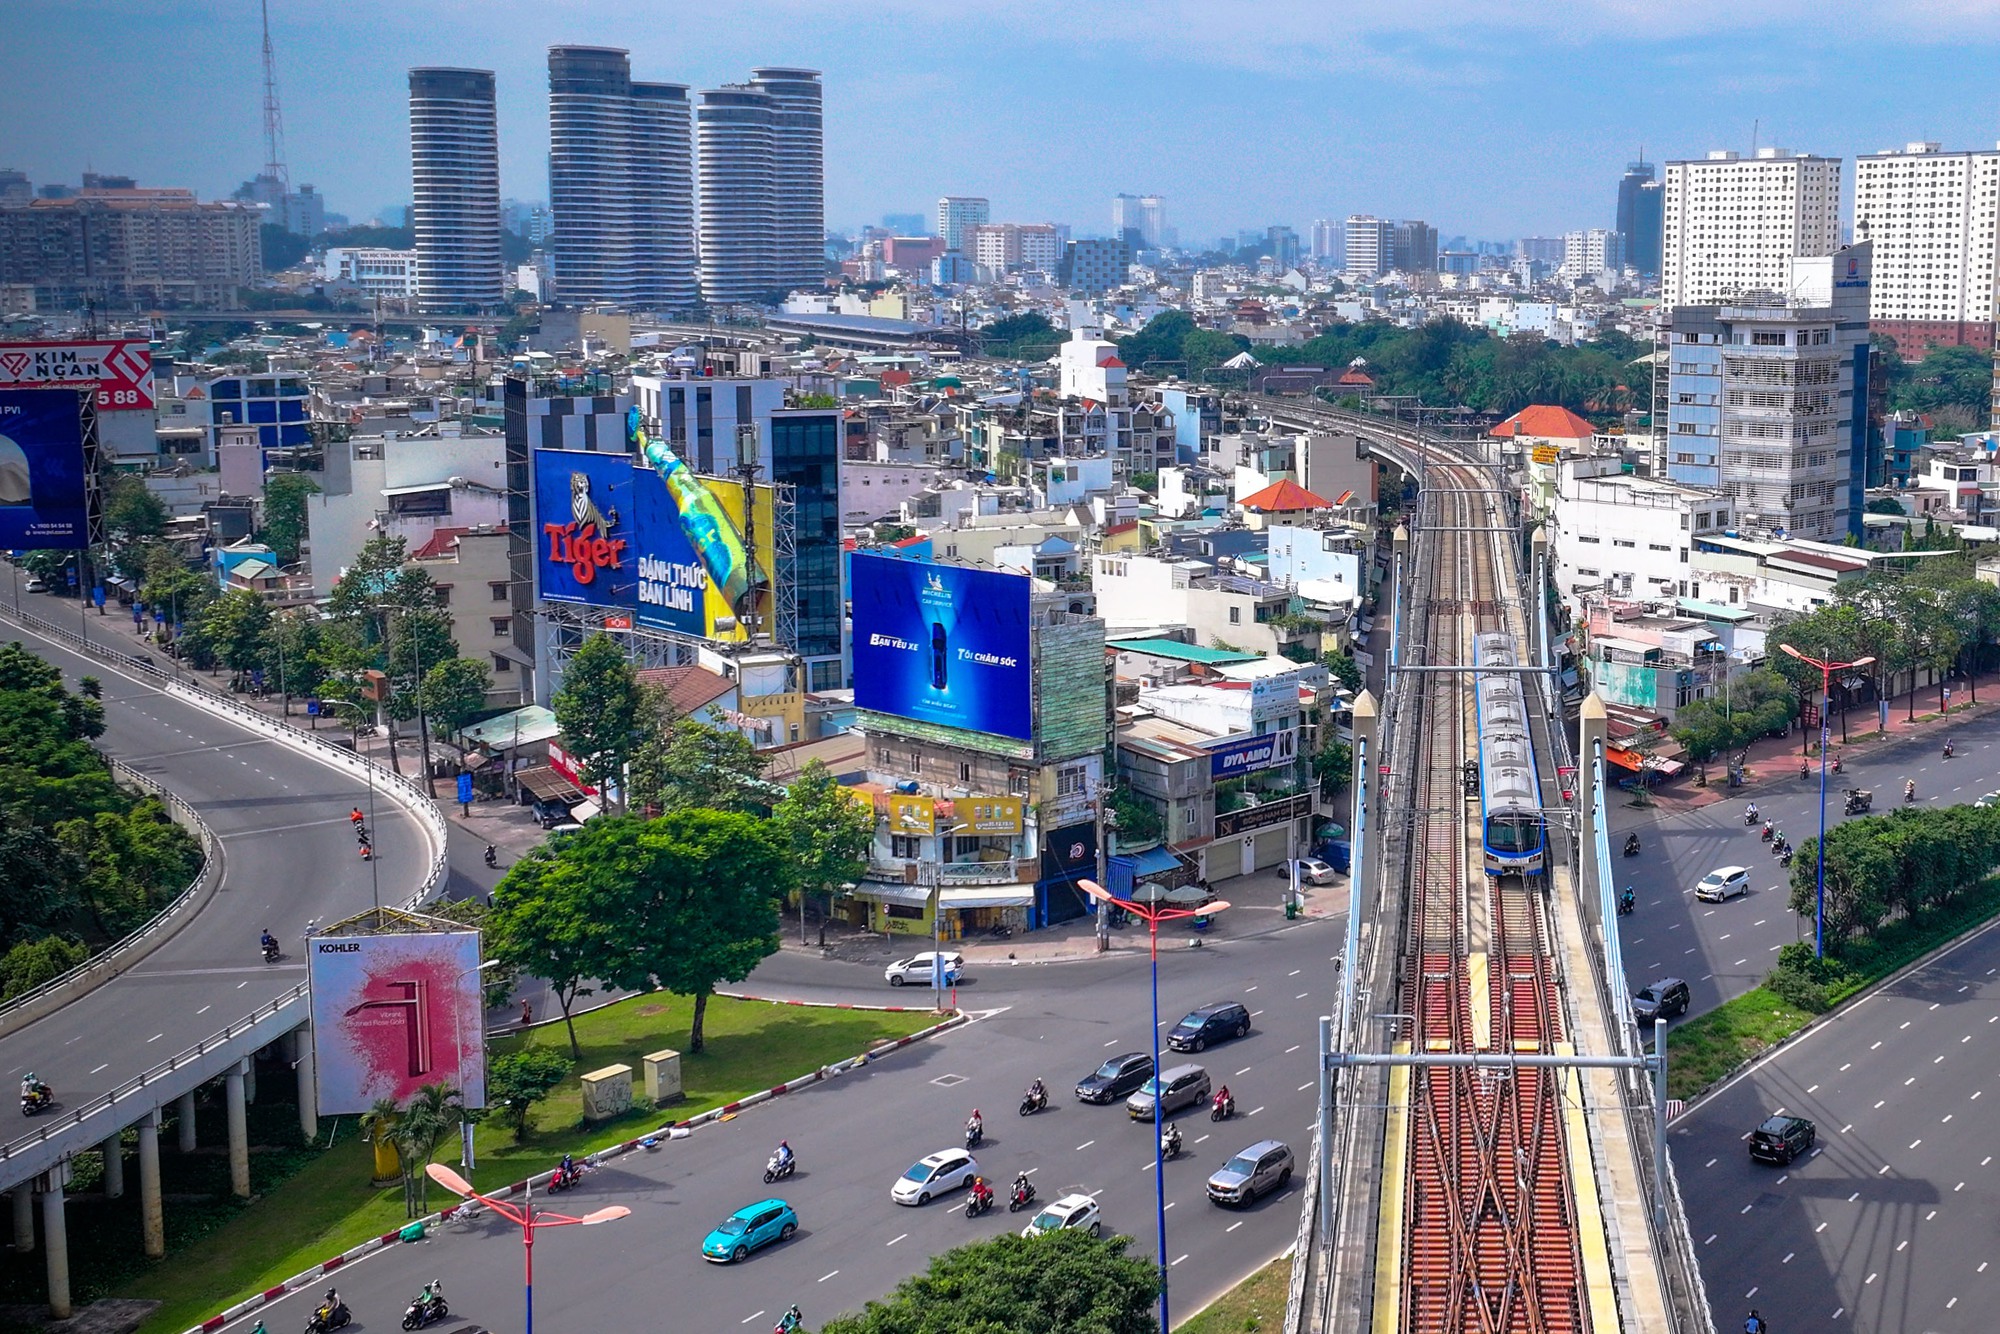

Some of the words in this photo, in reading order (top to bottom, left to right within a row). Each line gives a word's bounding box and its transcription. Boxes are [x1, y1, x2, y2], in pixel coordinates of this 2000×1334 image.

[35, 351, 77, 364] KIM
[36, 364, 100, 377] NGAN
[98, 391, 110, 405] 5
[114, 390, 138, 404] 88
[4, 406, 21, 415] PVI
[544, 521, 625, 585] Tiger
[637, 553, 671, 583] ĐÁNH
[672, 561, 708, 590] THỨC
[922, 589, 952, 599] MICHELIN
[870, 633, 890, 649] BẠN
[892, 638, 908, 650] YÊU
[908, 642, 919, 651] XE
[957, 648, 974, 661] TÔI
[1000, 656, 1017, 668] SÓC
[1223, 747, 1271, 768] DYNAMO
[1246, 760, 1271, 772] TIRES
[1264, 811, 1280, 820] NAM
[319, 943, 360, 953] KOHLER
